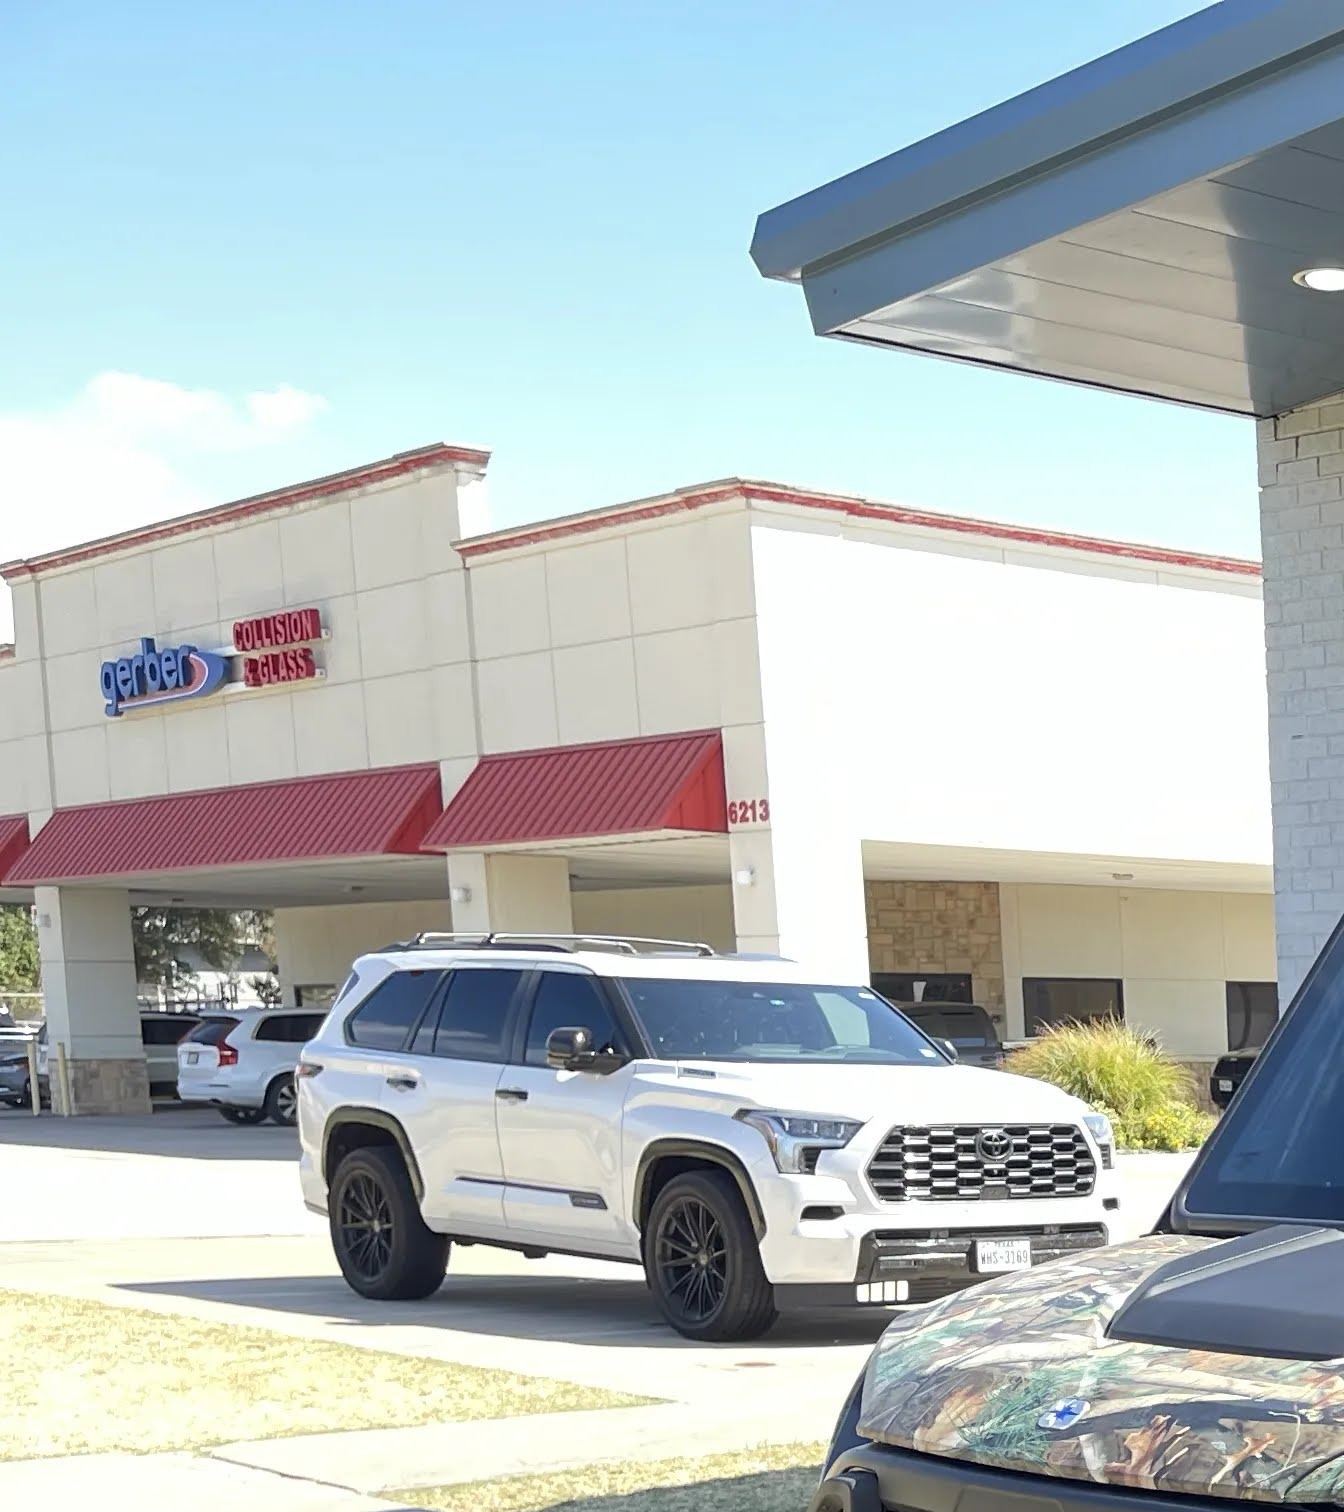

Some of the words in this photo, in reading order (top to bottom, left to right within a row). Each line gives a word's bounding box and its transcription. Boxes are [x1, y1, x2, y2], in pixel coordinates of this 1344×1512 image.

[232, 609, 320, 651] COLLISION
[101, 637, 198, 717] gerber
[258, 649, 314, 685] GLASS
[729, 799, 769, 824] 6213
